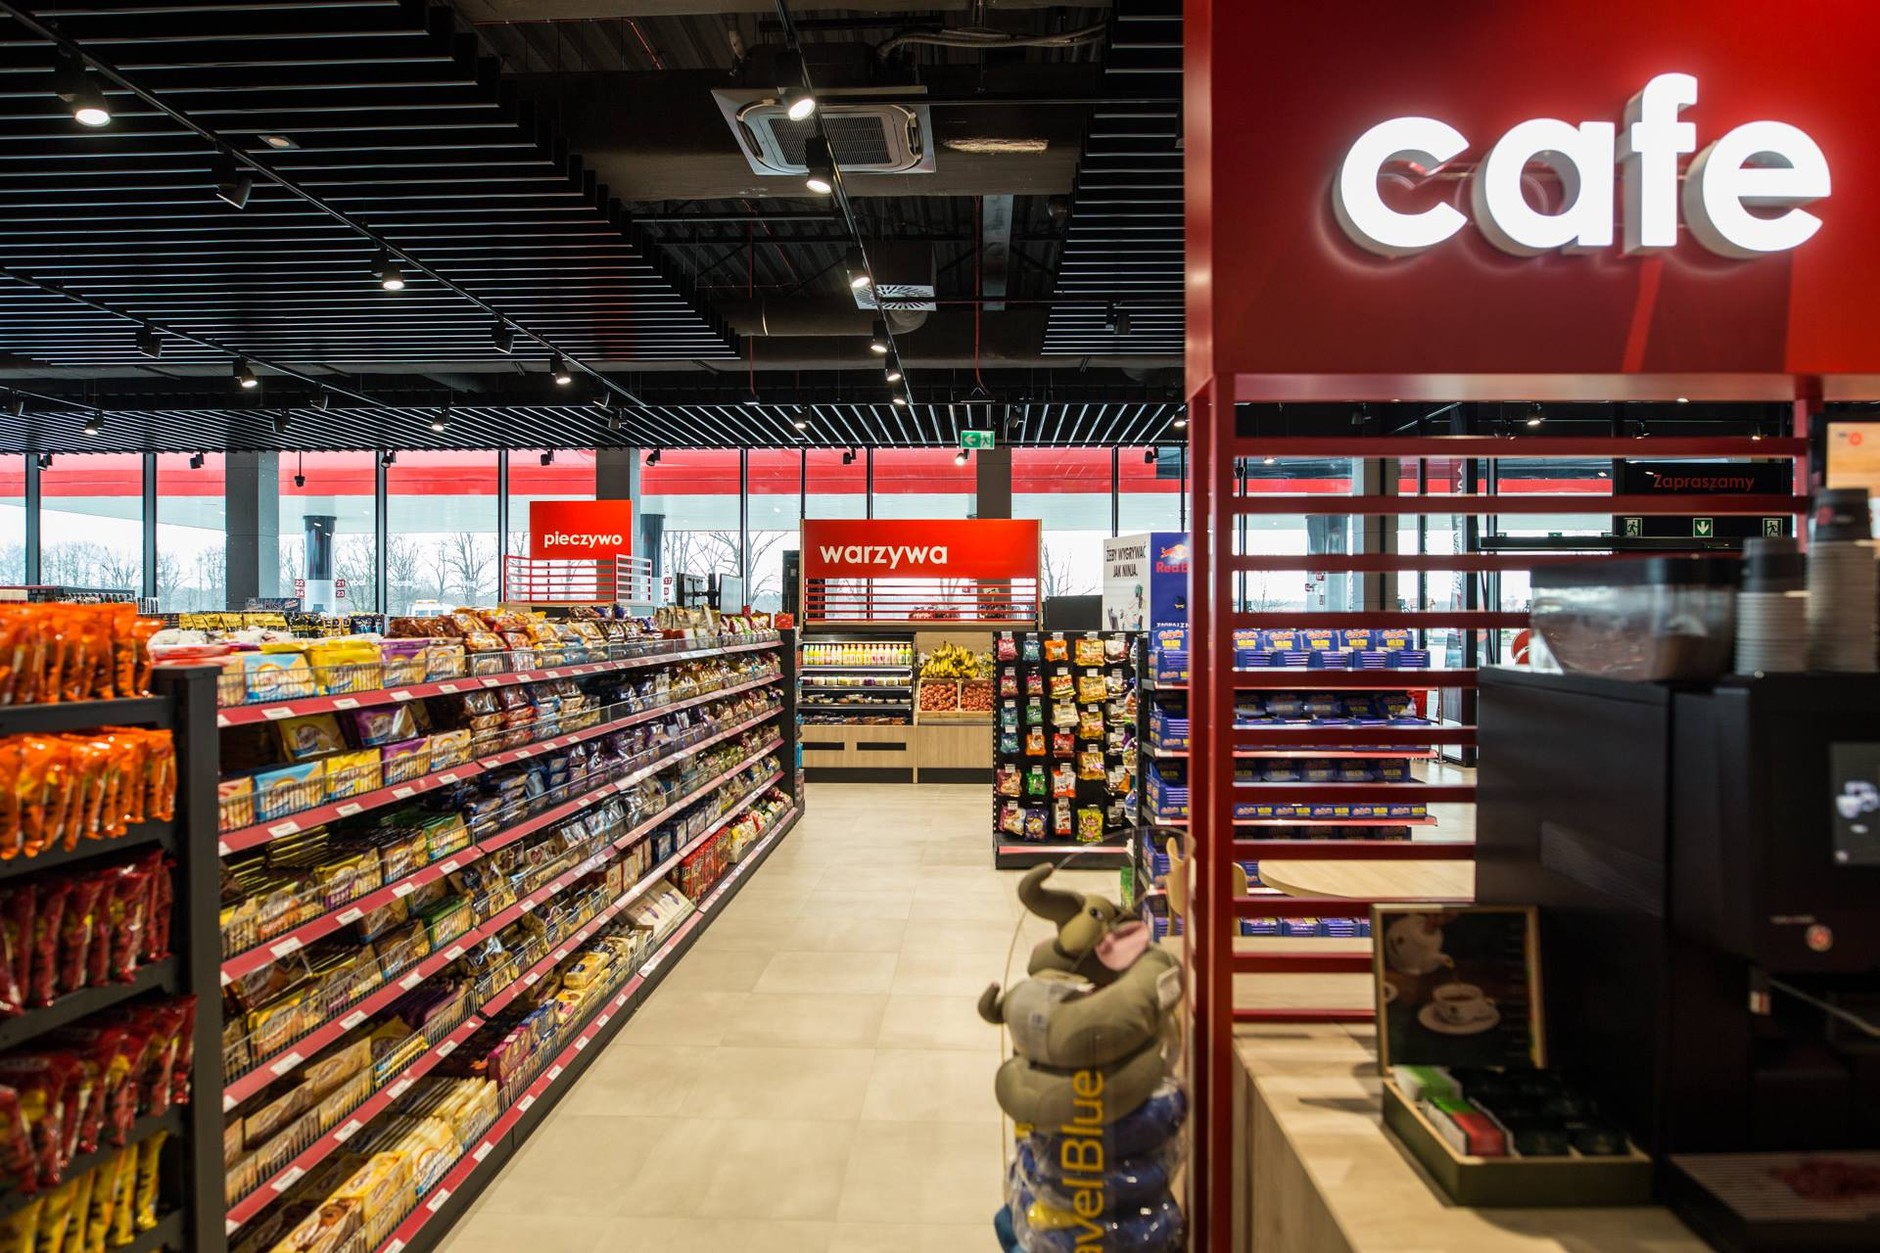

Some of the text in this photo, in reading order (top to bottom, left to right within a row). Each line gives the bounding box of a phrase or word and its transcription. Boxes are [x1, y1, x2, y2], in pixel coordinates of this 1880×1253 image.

[1339, 71, 1832, 255] cafe
[1653, 474, 1755, 491] Zapraszamy
[543, 530, 623, 549] pieczywo
[819, 544, 948, 570] warzywa
[1156, 562, 1180, 573] Red
